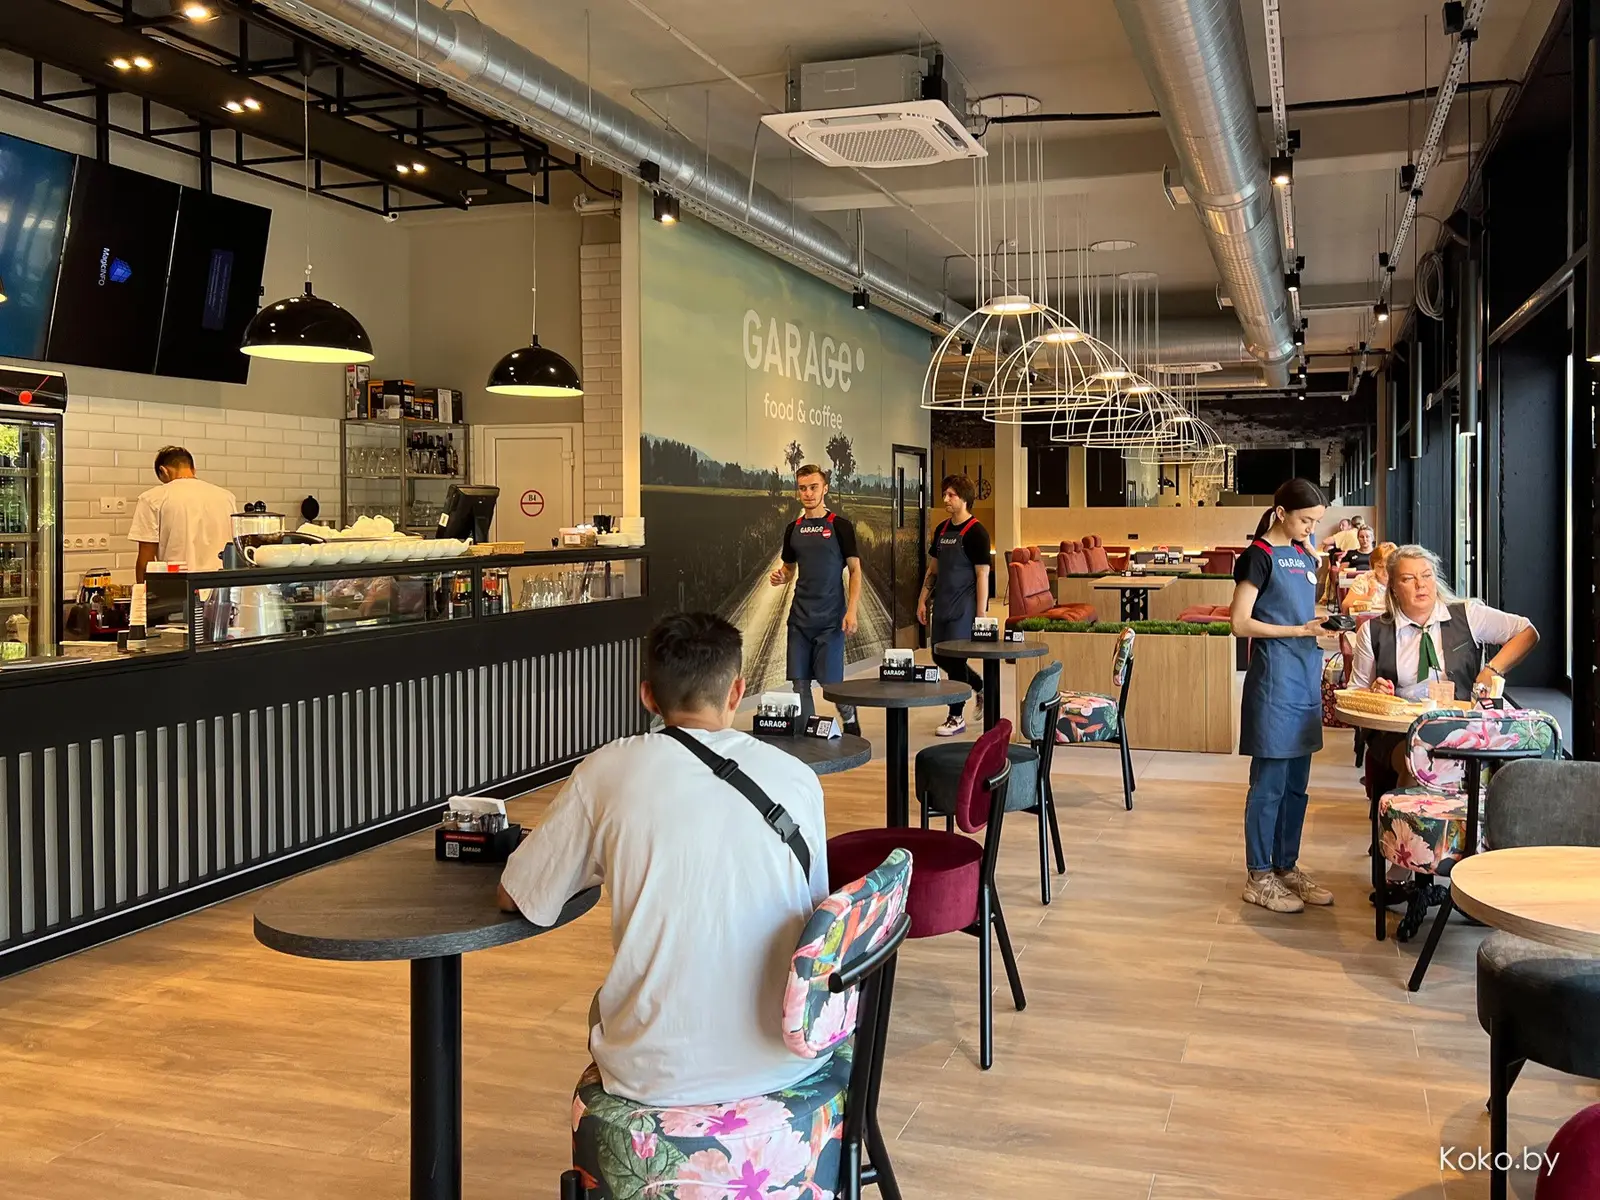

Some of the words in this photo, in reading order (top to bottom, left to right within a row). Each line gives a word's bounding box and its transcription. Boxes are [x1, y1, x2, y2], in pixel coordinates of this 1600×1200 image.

[98, 247, 110, 286] MagicINFO
[764, 393, 794, 421] food
[797, 399, 806, 424] &
[808, 405, 843, 429] coffee
